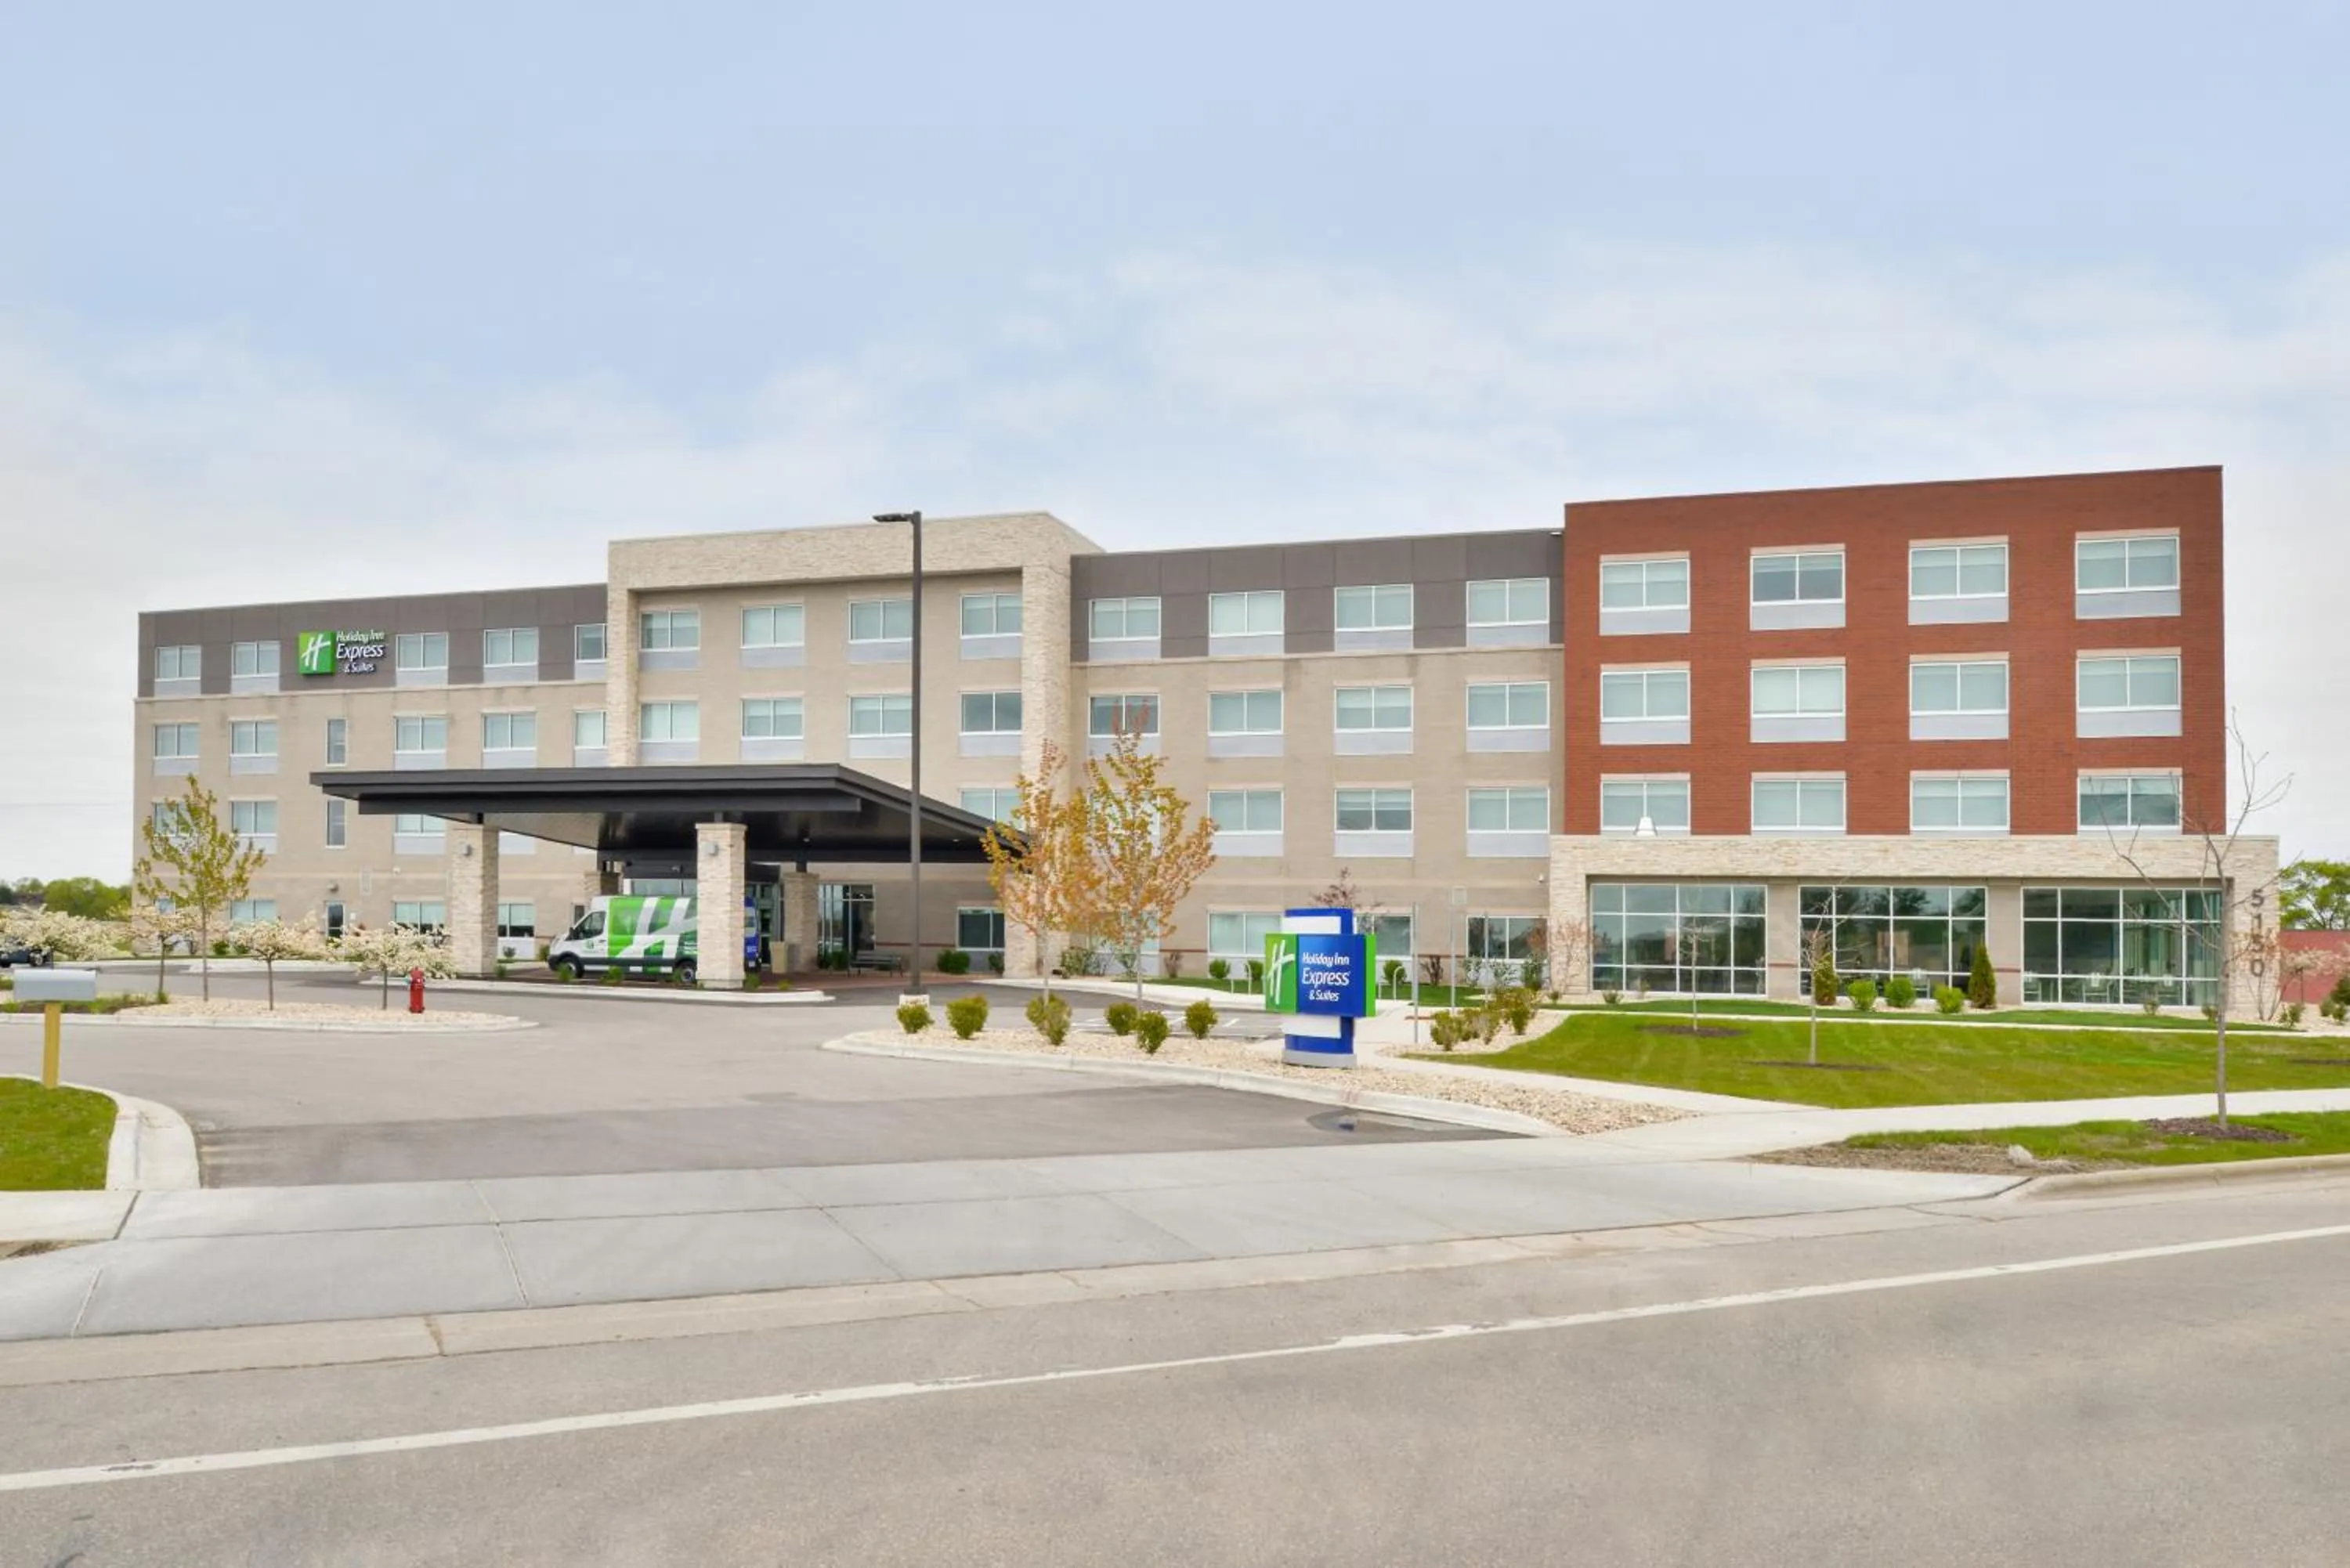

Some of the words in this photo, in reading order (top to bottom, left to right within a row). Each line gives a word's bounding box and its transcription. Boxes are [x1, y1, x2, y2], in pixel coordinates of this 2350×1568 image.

[336, 630, 369, 643] Holiday
[370, 629, 385, 641] Inn
[336, 643, 384, 661] Express
[1302, 952, 1333, 966] Holiday
[1334, 952, 1350, 965] Inn
[1302, 967, 1350, 988] Express
[1309, 990, 1315, 1000] &
[1315, 989, 1340, 1002] Suites
